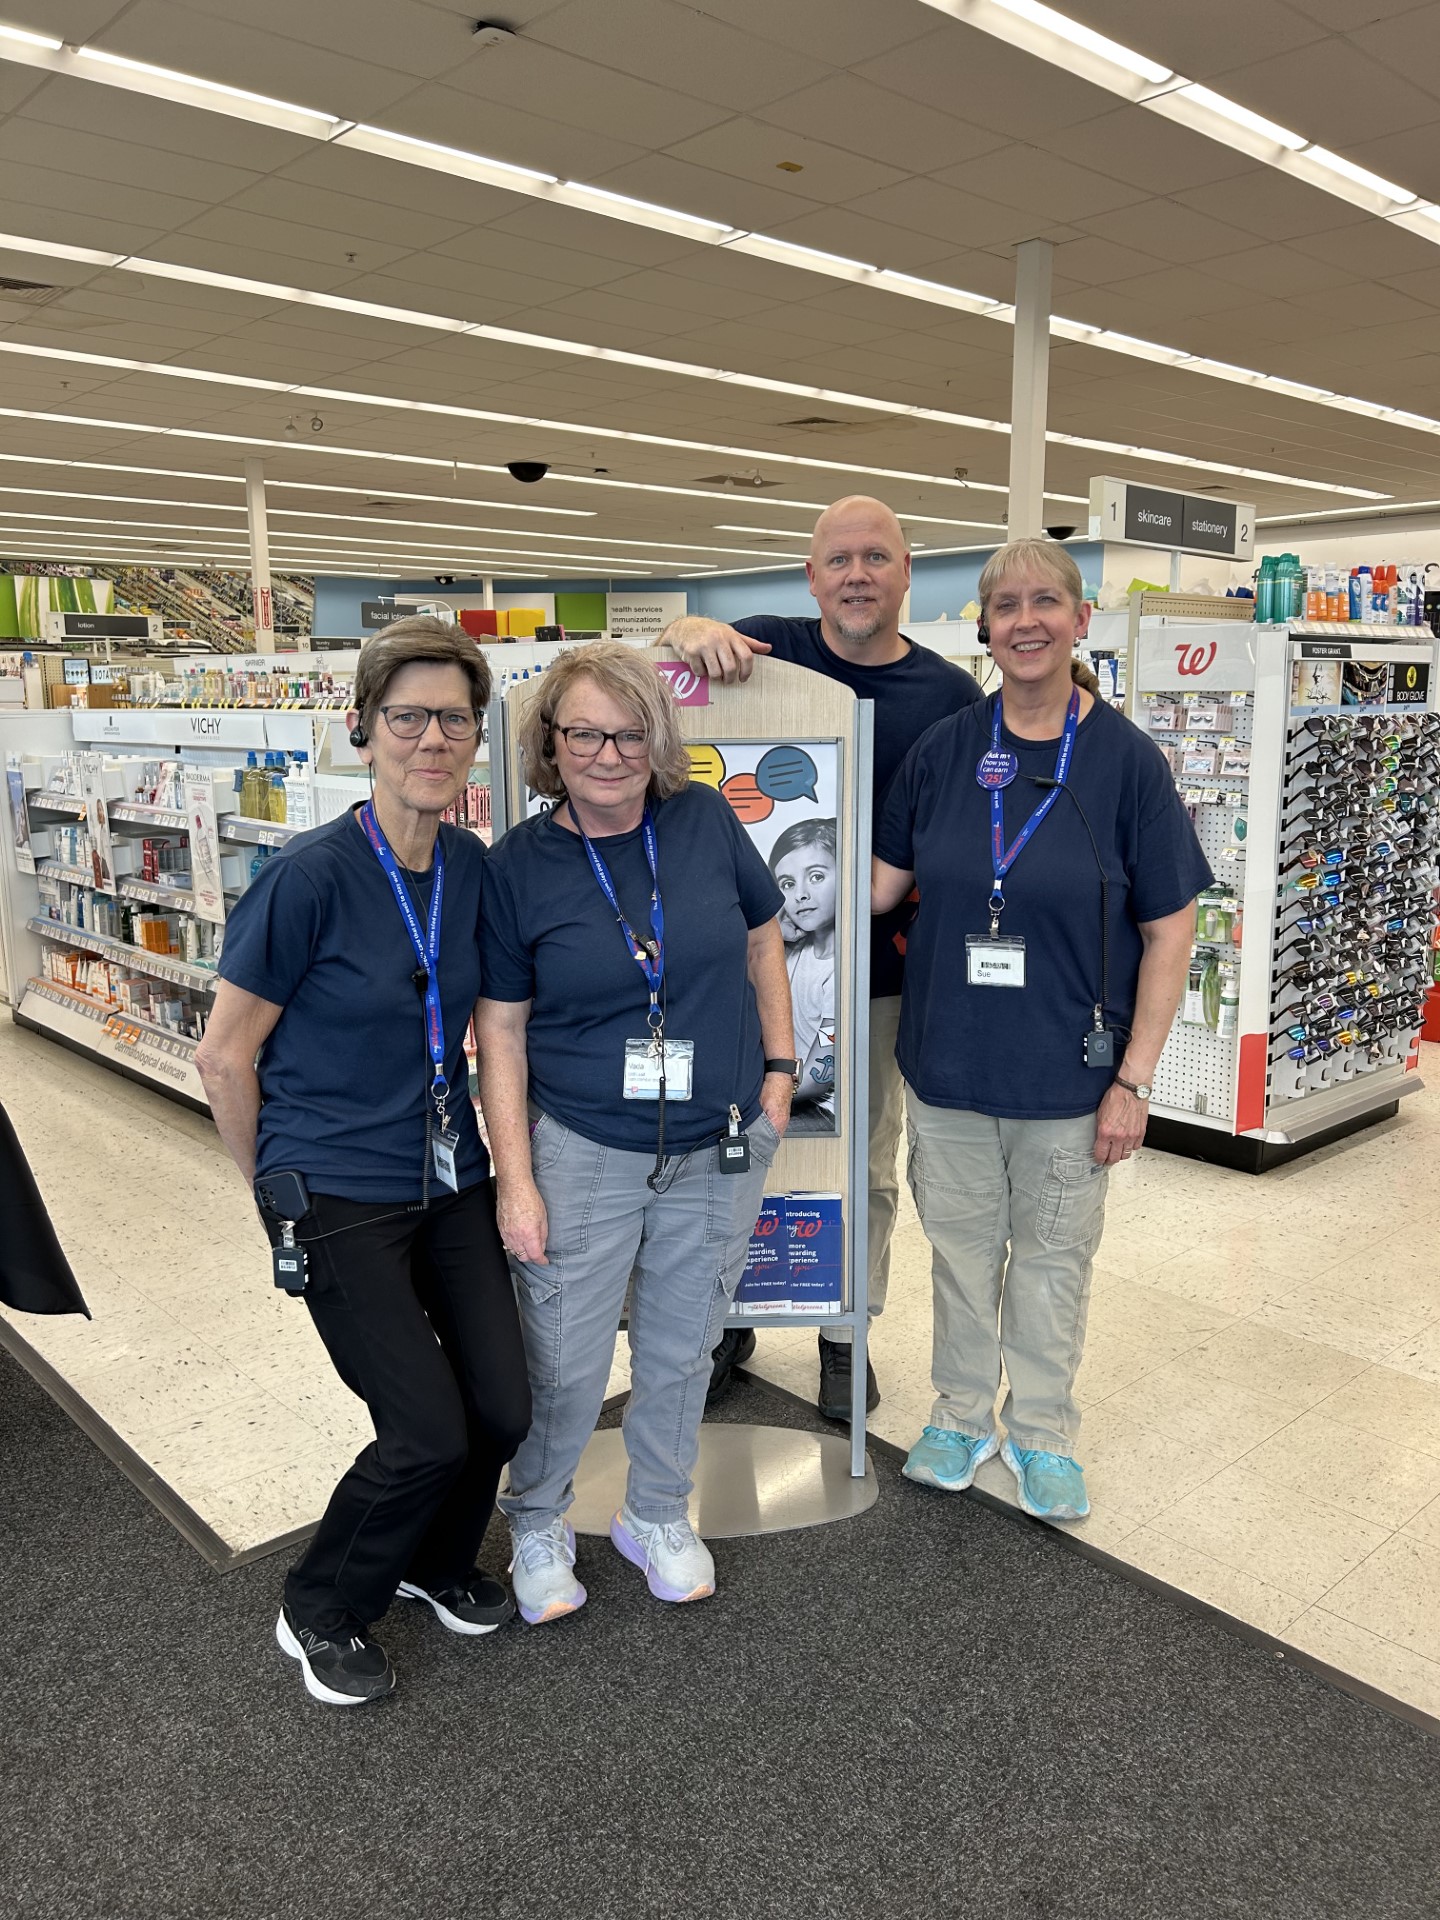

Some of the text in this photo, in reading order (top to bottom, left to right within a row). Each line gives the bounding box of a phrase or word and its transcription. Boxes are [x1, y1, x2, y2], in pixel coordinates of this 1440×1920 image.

[1111, 502, 1116, 521] 1
[1137, 509, 1172, 527] skincare
[1192, 520, 1228, 538] stationery
[1240, 524, 1248, 542] 2
[371, 611, 390, 620] facial
[1175, 642, 1217, 676] W
[1397, 691, 1425, 701] BODY GLOVE
[190, 718, 222, 735] VICHY
[185, 773, 211, 782] BIODERMA
[985, 774, 1003, 784] $25!
[389, 870, 399, 883] well
[394, 882, 404, 895] stay
[401, 901, 411, 913] well
[406, 913, 416, 927] pays
[410, 926, 420, 938] that
[415, 938, 424, 951] card
[977, 970, 991, 978] Sue
[115, 1041, 187, 1082] dermatological skincare
[786, 1211, 821, 1219] ntroducing
[754, 1265, 770, 1277] you
[793, 1266, 810, 1277] you
